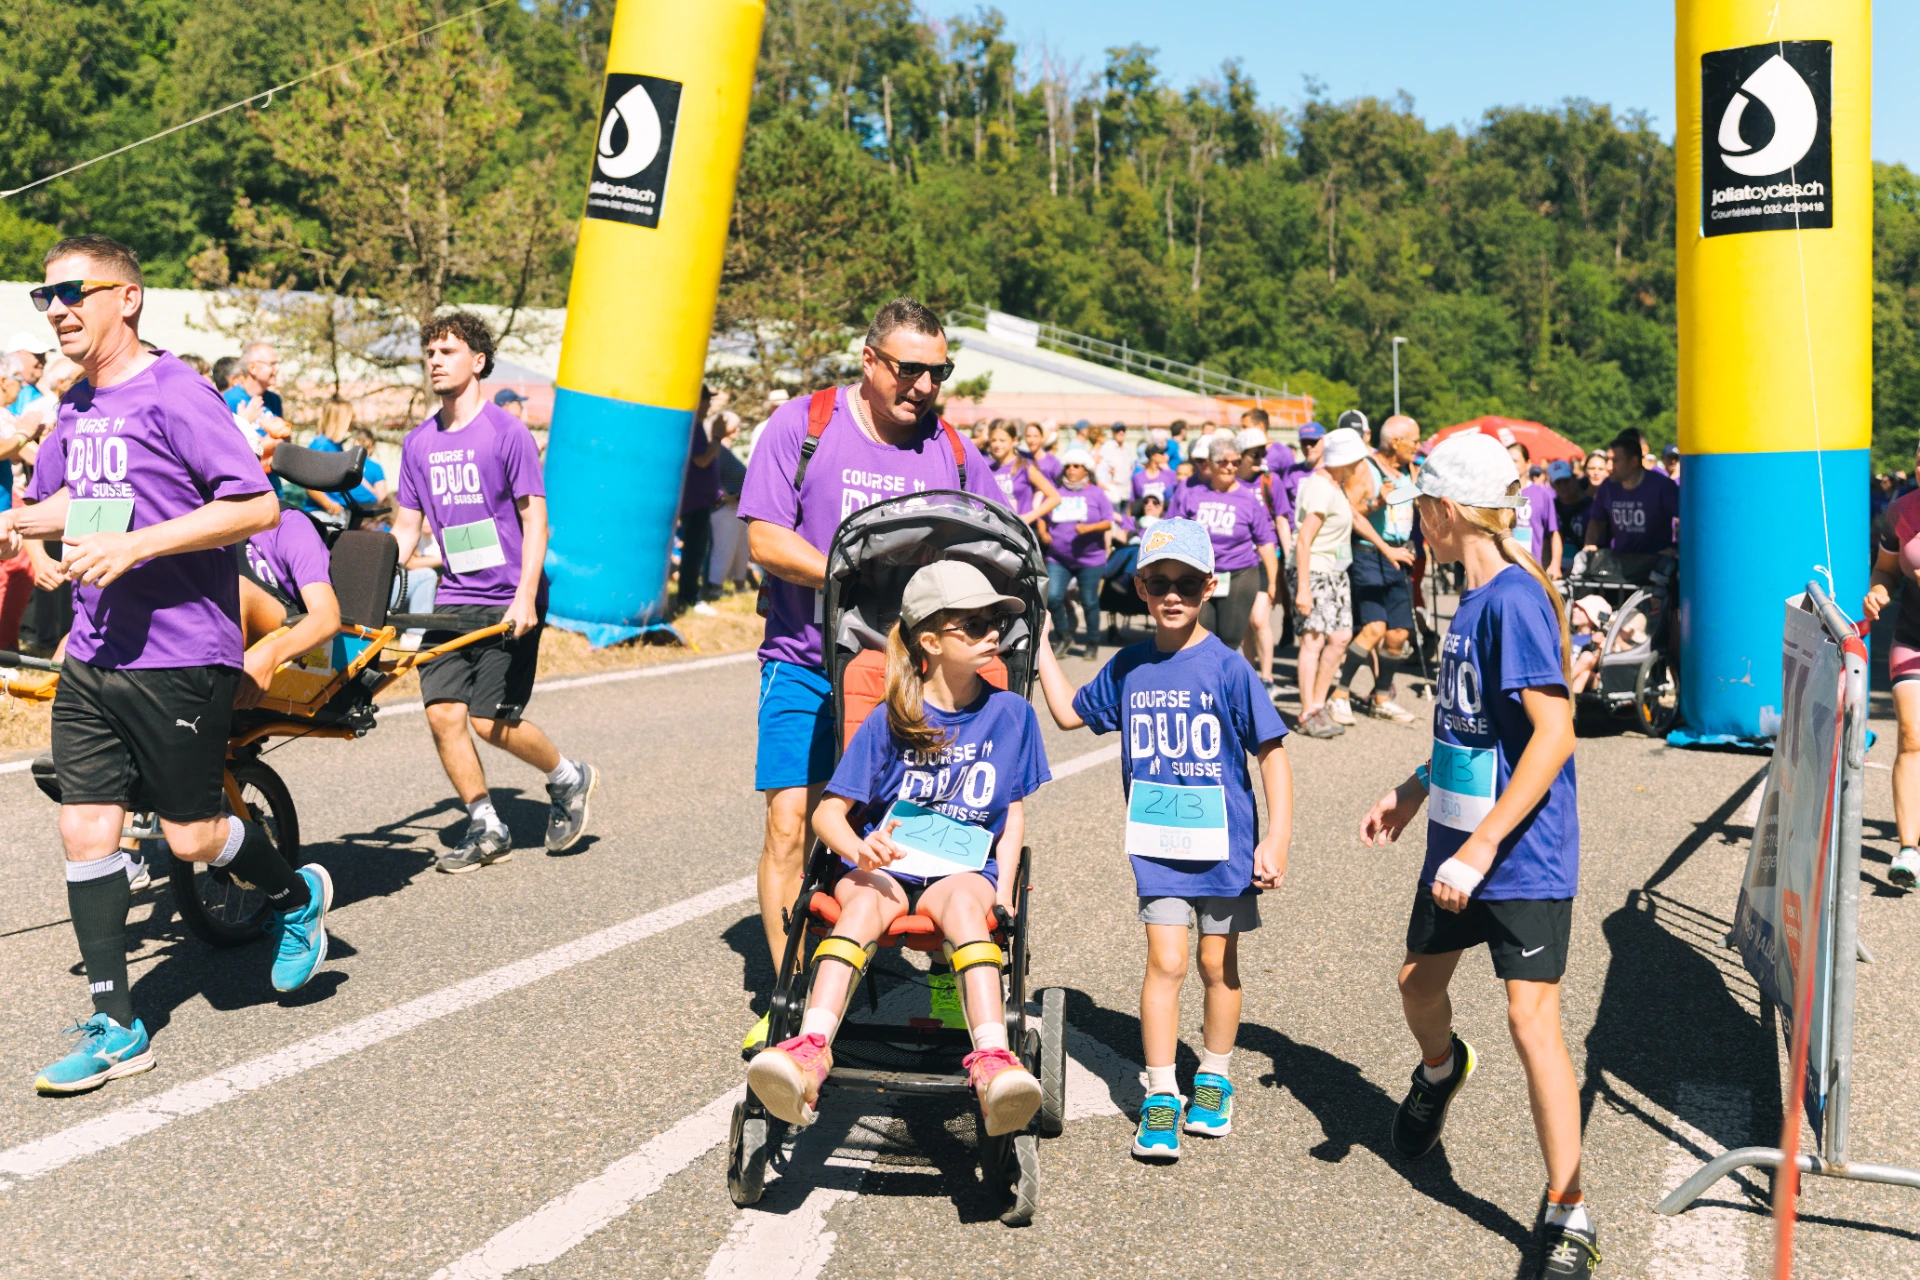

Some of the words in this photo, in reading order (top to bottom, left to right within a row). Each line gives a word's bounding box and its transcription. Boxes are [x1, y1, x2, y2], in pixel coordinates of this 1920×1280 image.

[1711, 180, 1824, 206] joliatcycles.ch
[67, 436, 128, 482] DUO
[429, 449, 463, 464] COURSE
[92, 483, 133, 498] SUISSE
[430, 463, 480, 495] DUO
[842, 468, 905, 492] COURSE
[454, 493, 484, 505] SUISSE
[1197, 509, 1236, 528] DUO
[461, 526, 475, 551] 1
[1436, 658, 1481, 714] UO
[1130, 689, 1190, 708] COURSE
[1130, 712, 1221, 760] DUO
[1444, 713, 1488, 735] SUISSE
[903, 742, 977, 766] COURSE
[1171, 762, 1222, 777] SUISSE
[897, 761, 997, 808] DUO
[1144, 789, 1204, 820] 213
[904, 812, 972, 857] 213
